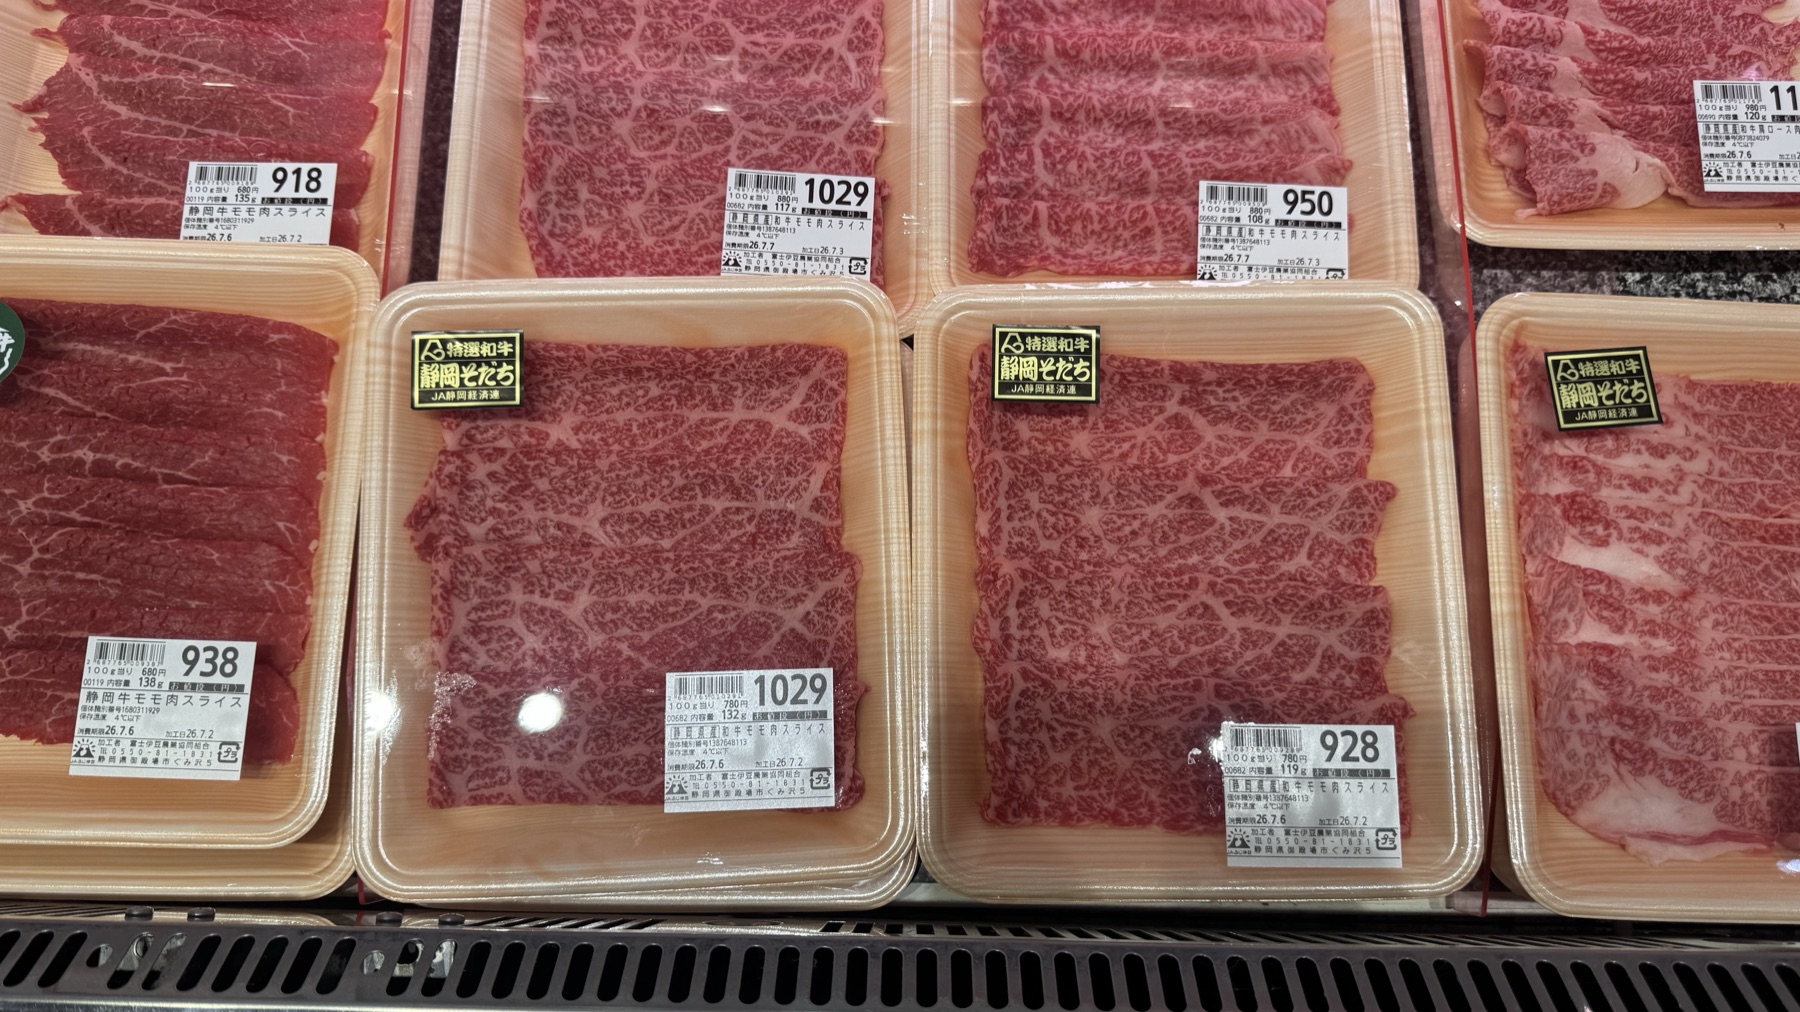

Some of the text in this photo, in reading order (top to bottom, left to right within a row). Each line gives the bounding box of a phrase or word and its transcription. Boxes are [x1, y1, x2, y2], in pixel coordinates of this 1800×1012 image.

[1770, 85, 1798, 110] 11
[272, 167, 322, 193] 918
[777, 195, 798, 203] 880円
[805, 178, 869, 206] 1029
[1283, 189, 1333, 216] 950
[189, 206, 326, 217] 静岡牛モモ肉スライス
[1250, 207, 1270, 215] 880円
[447, 341, 513, 358] 特選和牛
[1026, 336, 1089, 352] 特選和牛
[420, 361, 514, 388] 静岡そだち
[1001, 356, 1090, 382] 静岡そだち
[1578, 359, 1640, 377] 特選和牛
[432, 390, 500, 401] JA静岡経済連
[1011, 384, 1076, 394] JA静岡経済連
[1559, 379, 1647, 408] 静岡そだち
[1576, 408, 1638, 420] JA静岡経済連
[182, 645, 239, 678] 938
[142, 668, 166, 676] 680円
[107, 679, 130, 687] 内容量
[754, 673, 827, 706] 1029
[86, 691, 242, 708] 静岡牛モモ肉スライス
[724, 700, 748, 709] 780円
[130, 740, 209, 749] 富士伊豆農業協同組合
[1320, 730, 1380, 763] 928
[1282, 754, 1307, 763] 780円
[689, 773, 712, 781] 加工者
[1284, 829, 1365, 837] 富士伊豆農業協同組合
